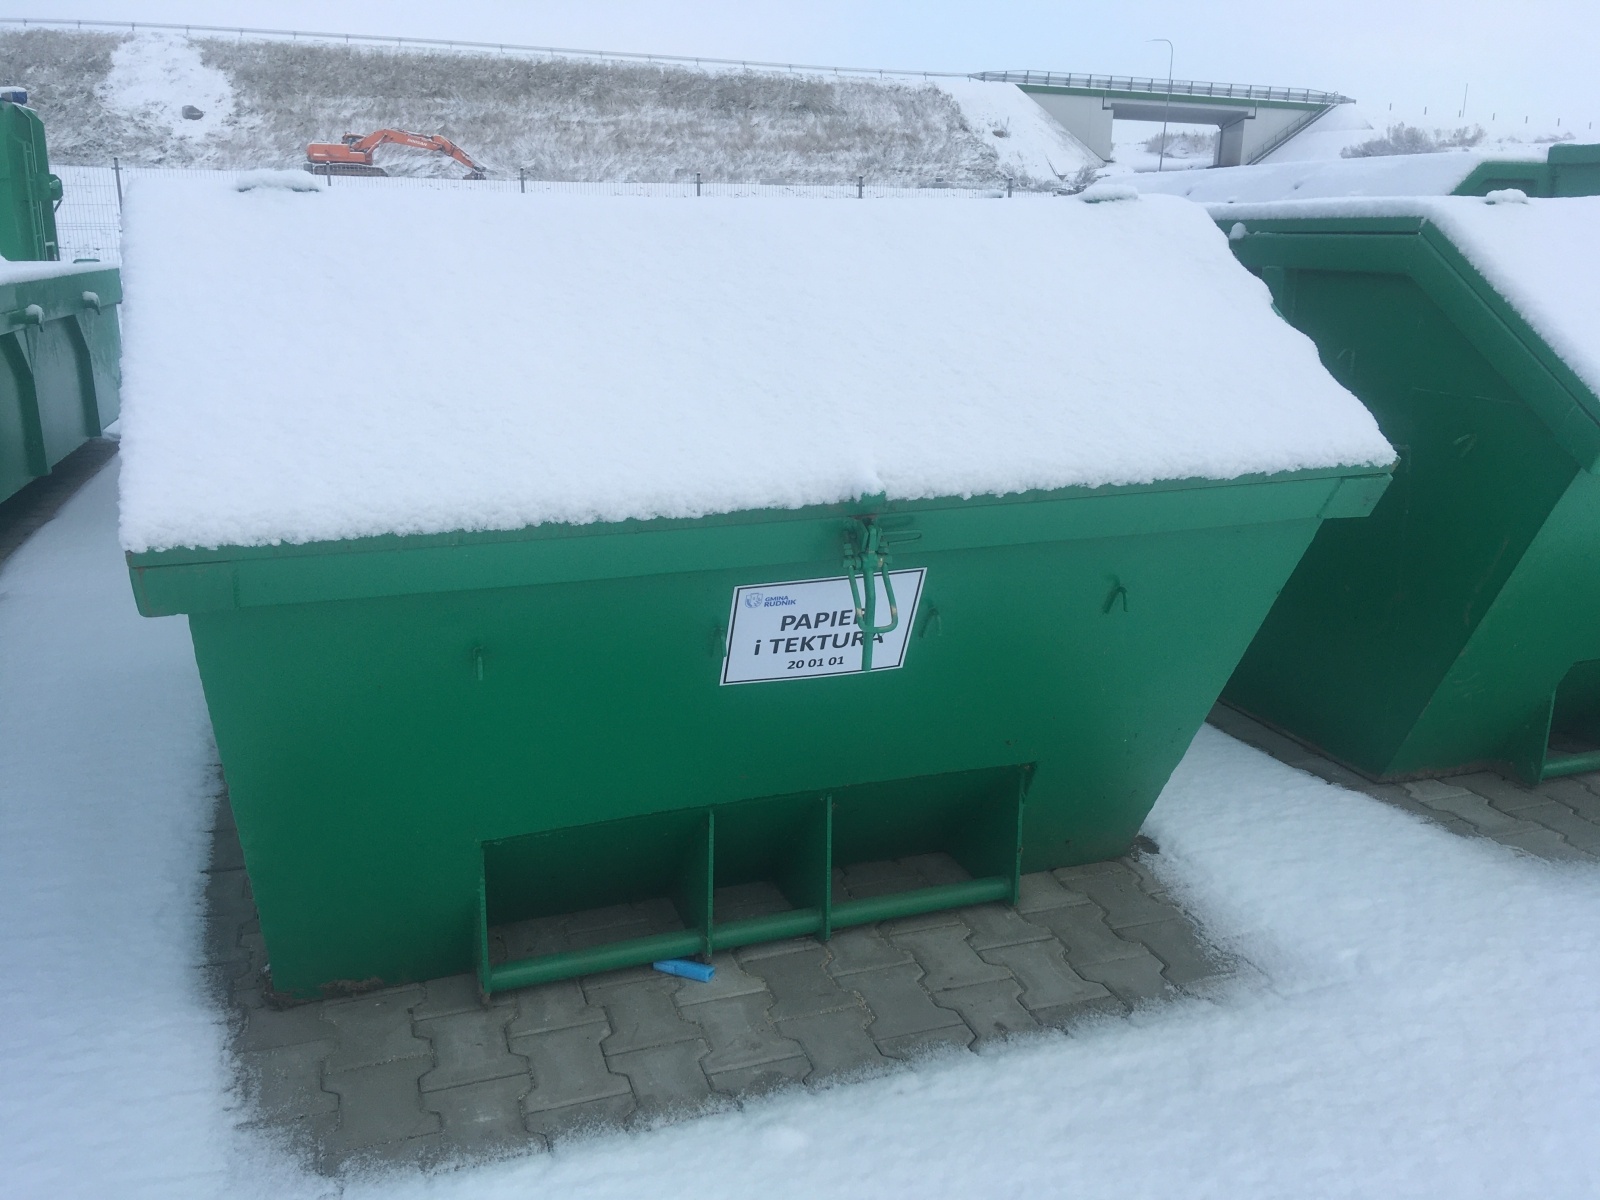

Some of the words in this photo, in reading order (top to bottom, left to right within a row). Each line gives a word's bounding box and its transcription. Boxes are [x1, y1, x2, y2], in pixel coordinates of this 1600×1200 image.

[764, 599, 796, 607] RUDNIK
[754, 640, 762, 655] i
[787, 659, 804, 669] 20
[808, 657, 824, 667] 01
[828, 656, 844, 666] 01
